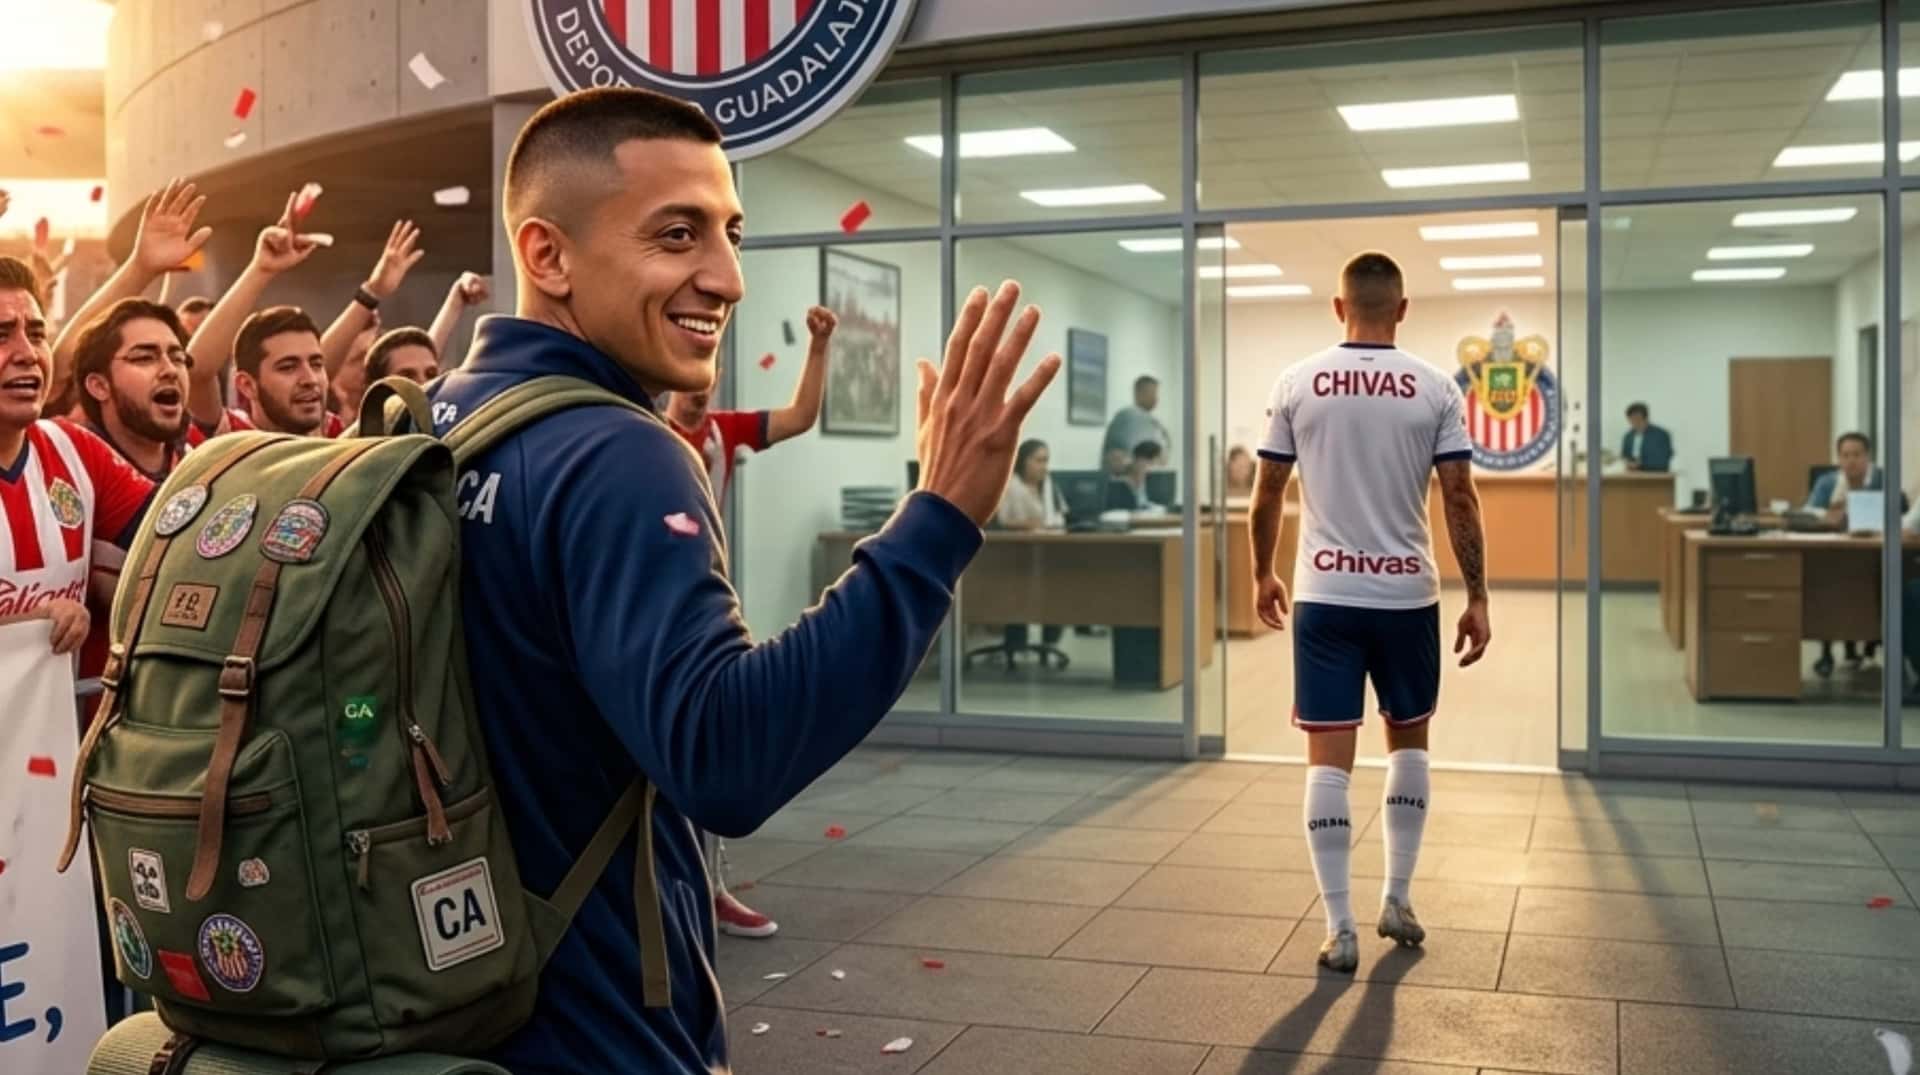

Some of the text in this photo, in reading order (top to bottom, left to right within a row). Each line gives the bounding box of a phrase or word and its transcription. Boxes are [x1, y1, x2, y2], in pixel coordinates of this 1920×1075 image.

[556, 0, 868, 124] DEPO GUADALAJ
[1313, 370, 1416, 398] CHIVAS
[1314, 550, 1420, 574] Chivas
[434, 887, 486, 940] CA
